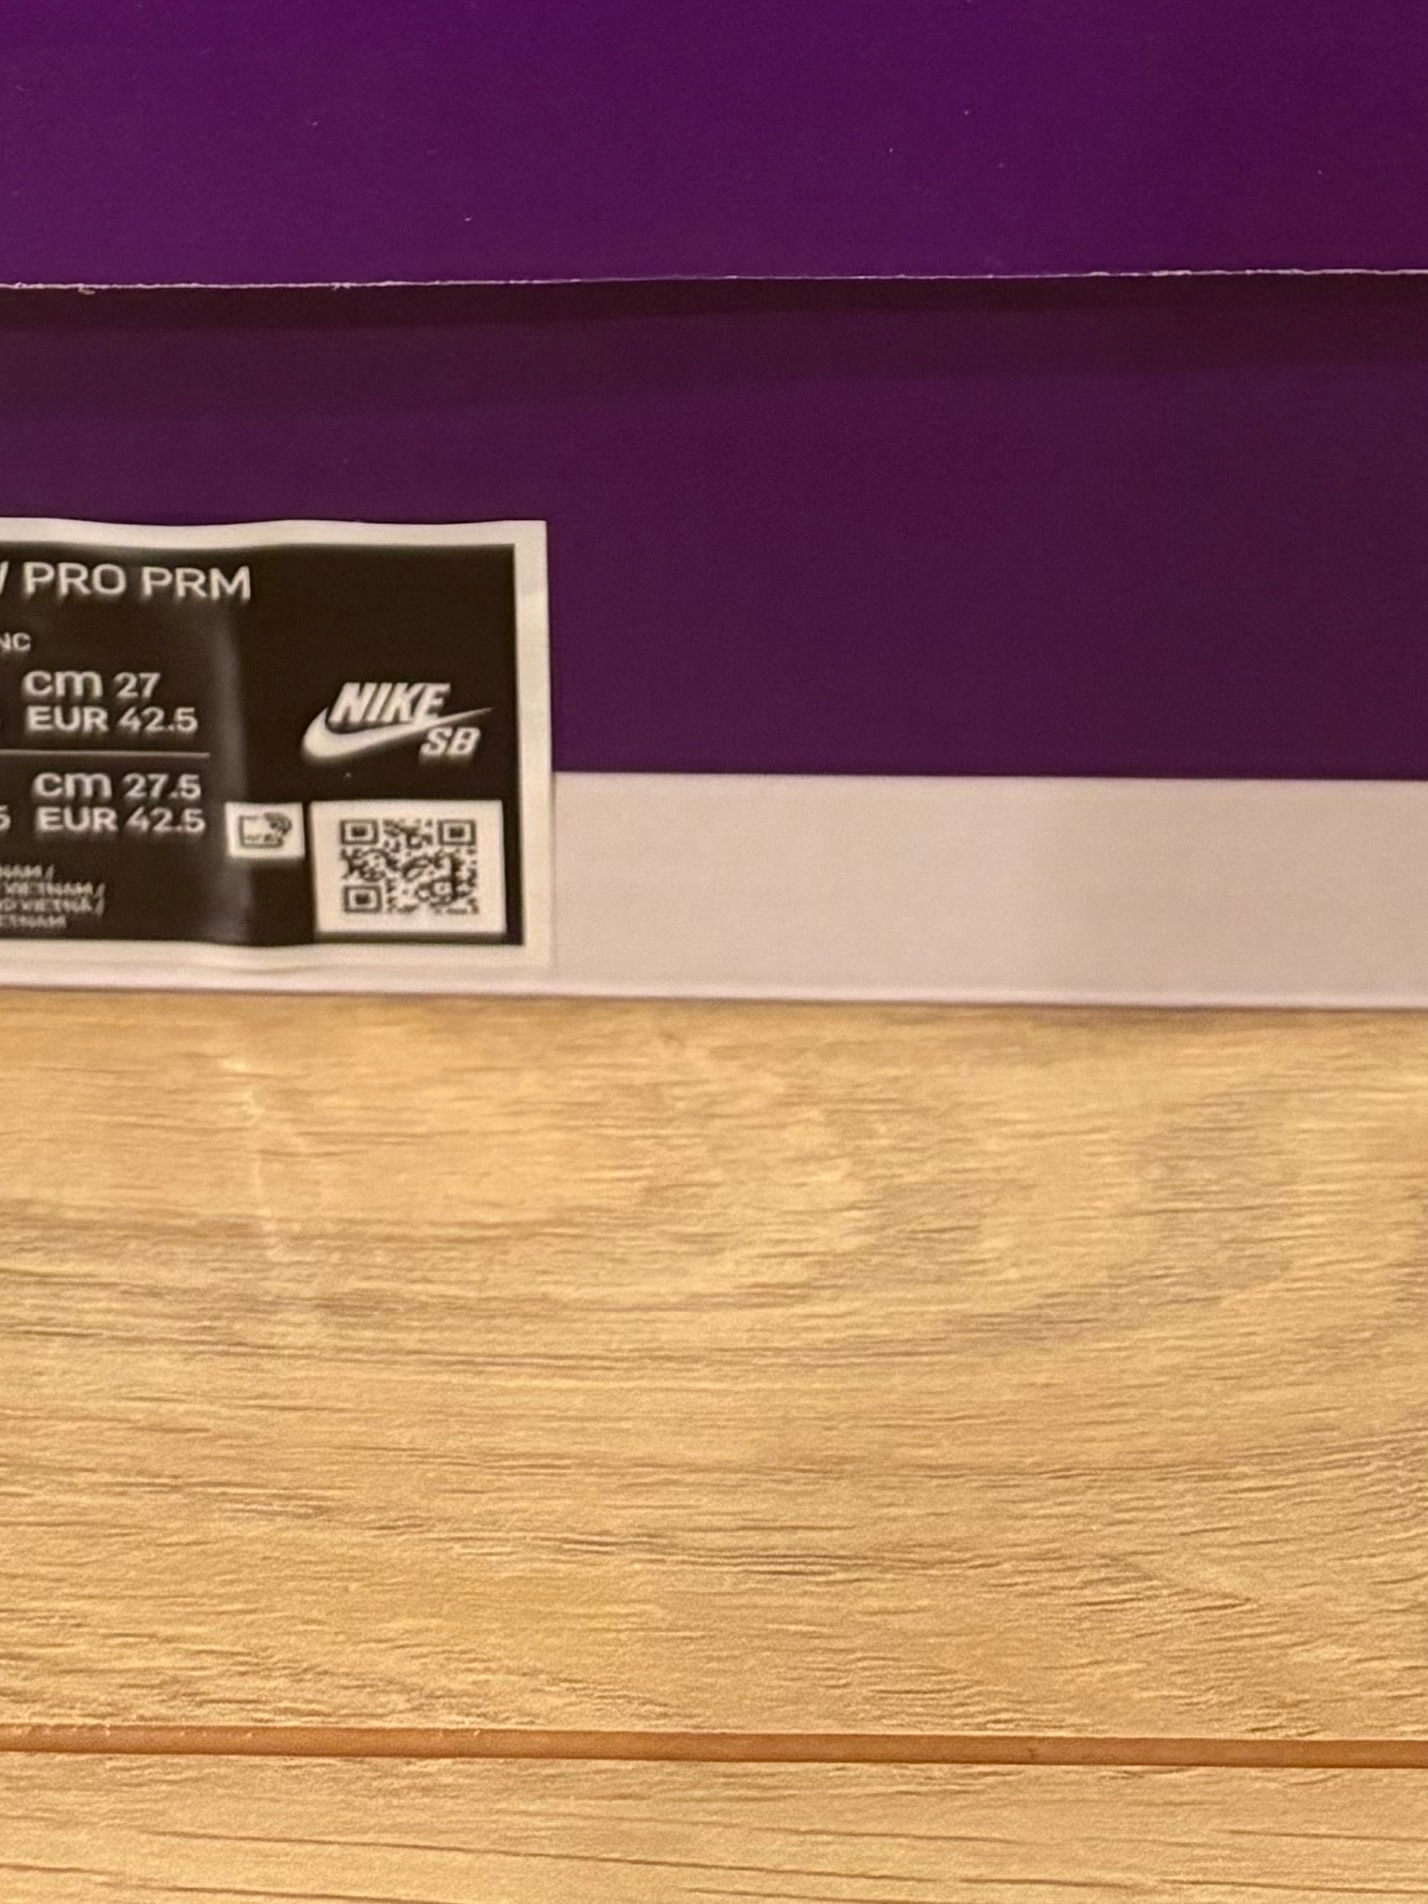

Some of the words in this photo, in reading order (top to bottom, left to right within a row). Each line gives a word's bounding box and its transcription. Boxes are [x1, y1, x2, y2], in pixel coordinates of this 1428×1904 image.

[22, 561, 126, 596] PRO
[141, 565, 252, 600] PRM
[22, 670, 103, 697] cm
[113, 672, 161, 698] 27
[327, 681, 452, 723] NIKE
[26, 705, 109, 732] EUR
[118, 707, 199, 733] 42.5
[419, 726, 481, 757] SB
[32, 772, 113, 798] cm
[123, 773, 202, 799] 27.5
[37, 806, 119, 832] EUR
[127, 808, 207, 834] 42.5
